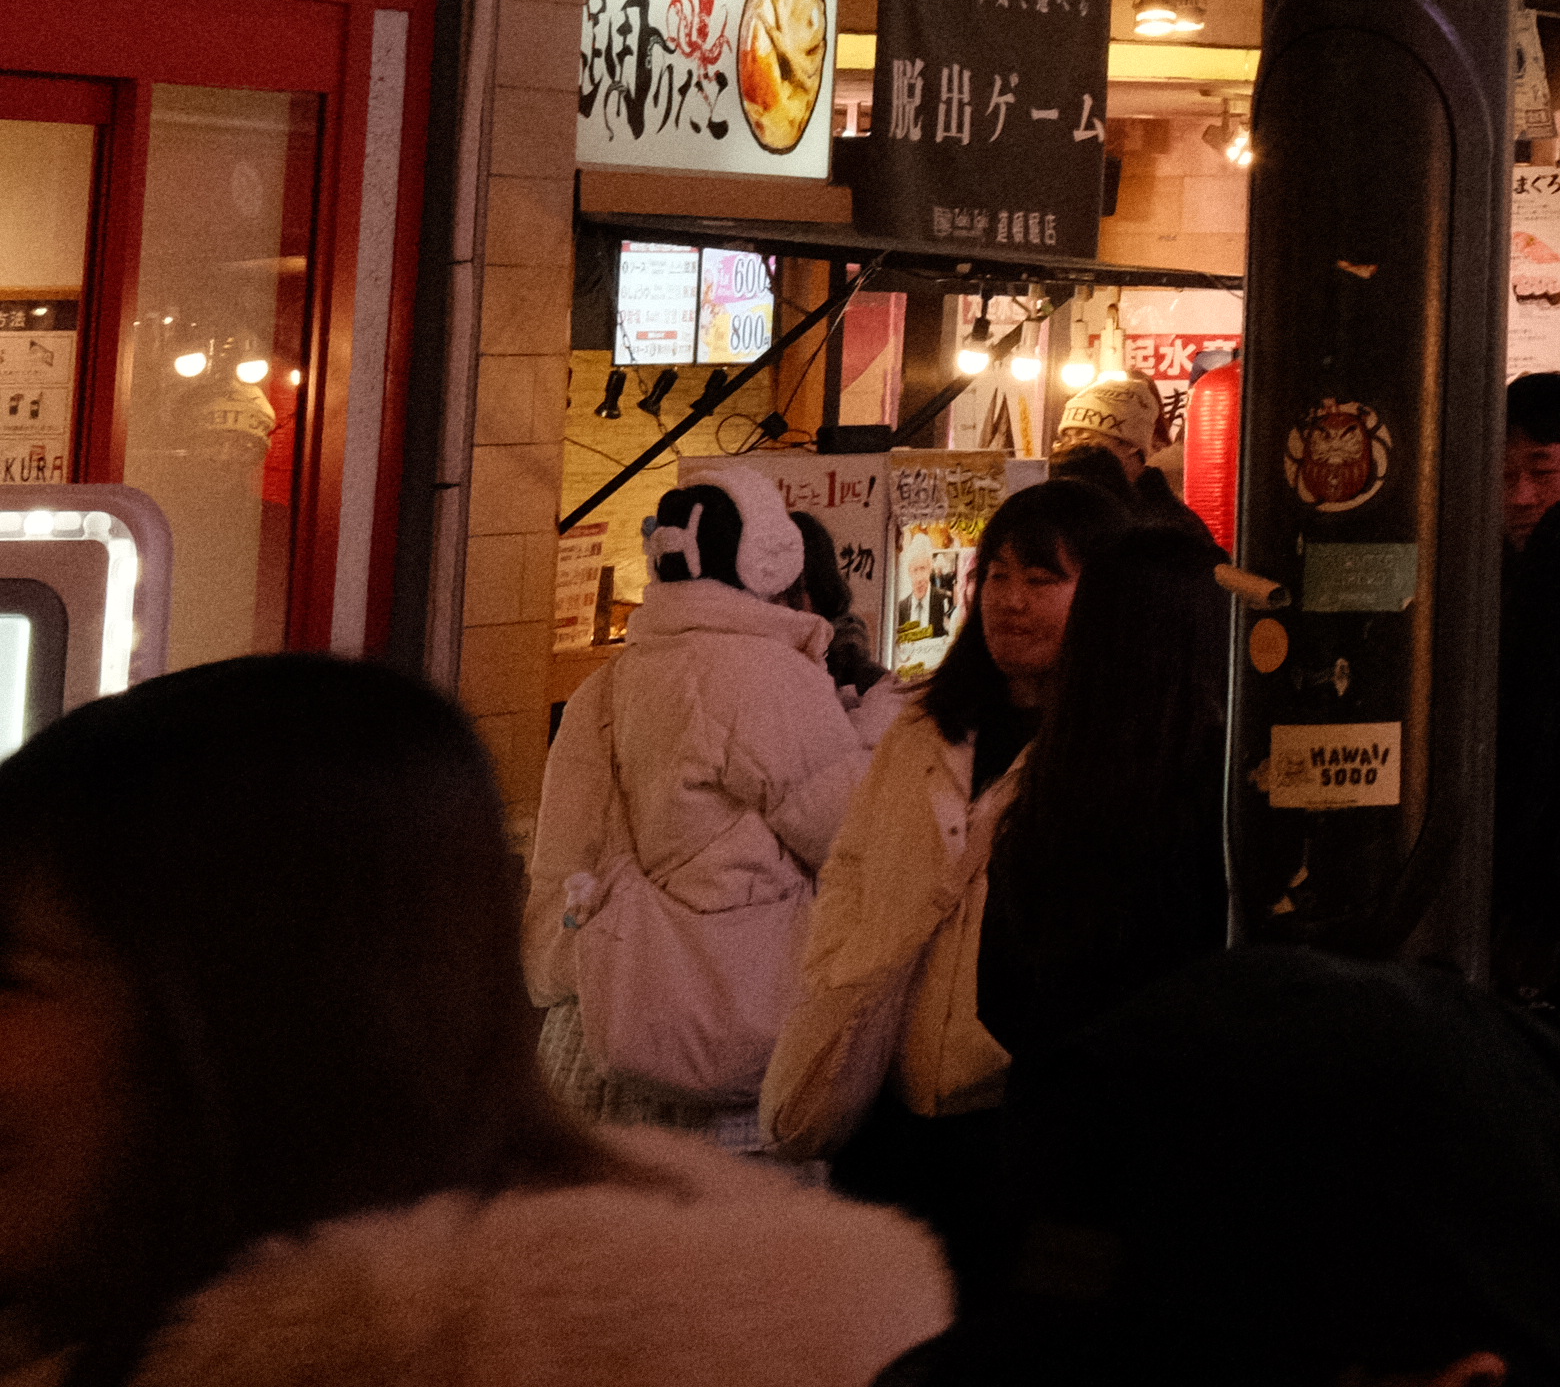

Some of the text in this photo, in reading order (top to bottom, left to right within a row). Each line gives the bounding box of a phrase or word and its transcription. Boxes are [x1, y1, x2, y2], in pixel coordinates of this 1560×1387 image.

[888, 57, 1105, 145] 脱出ゲーム
